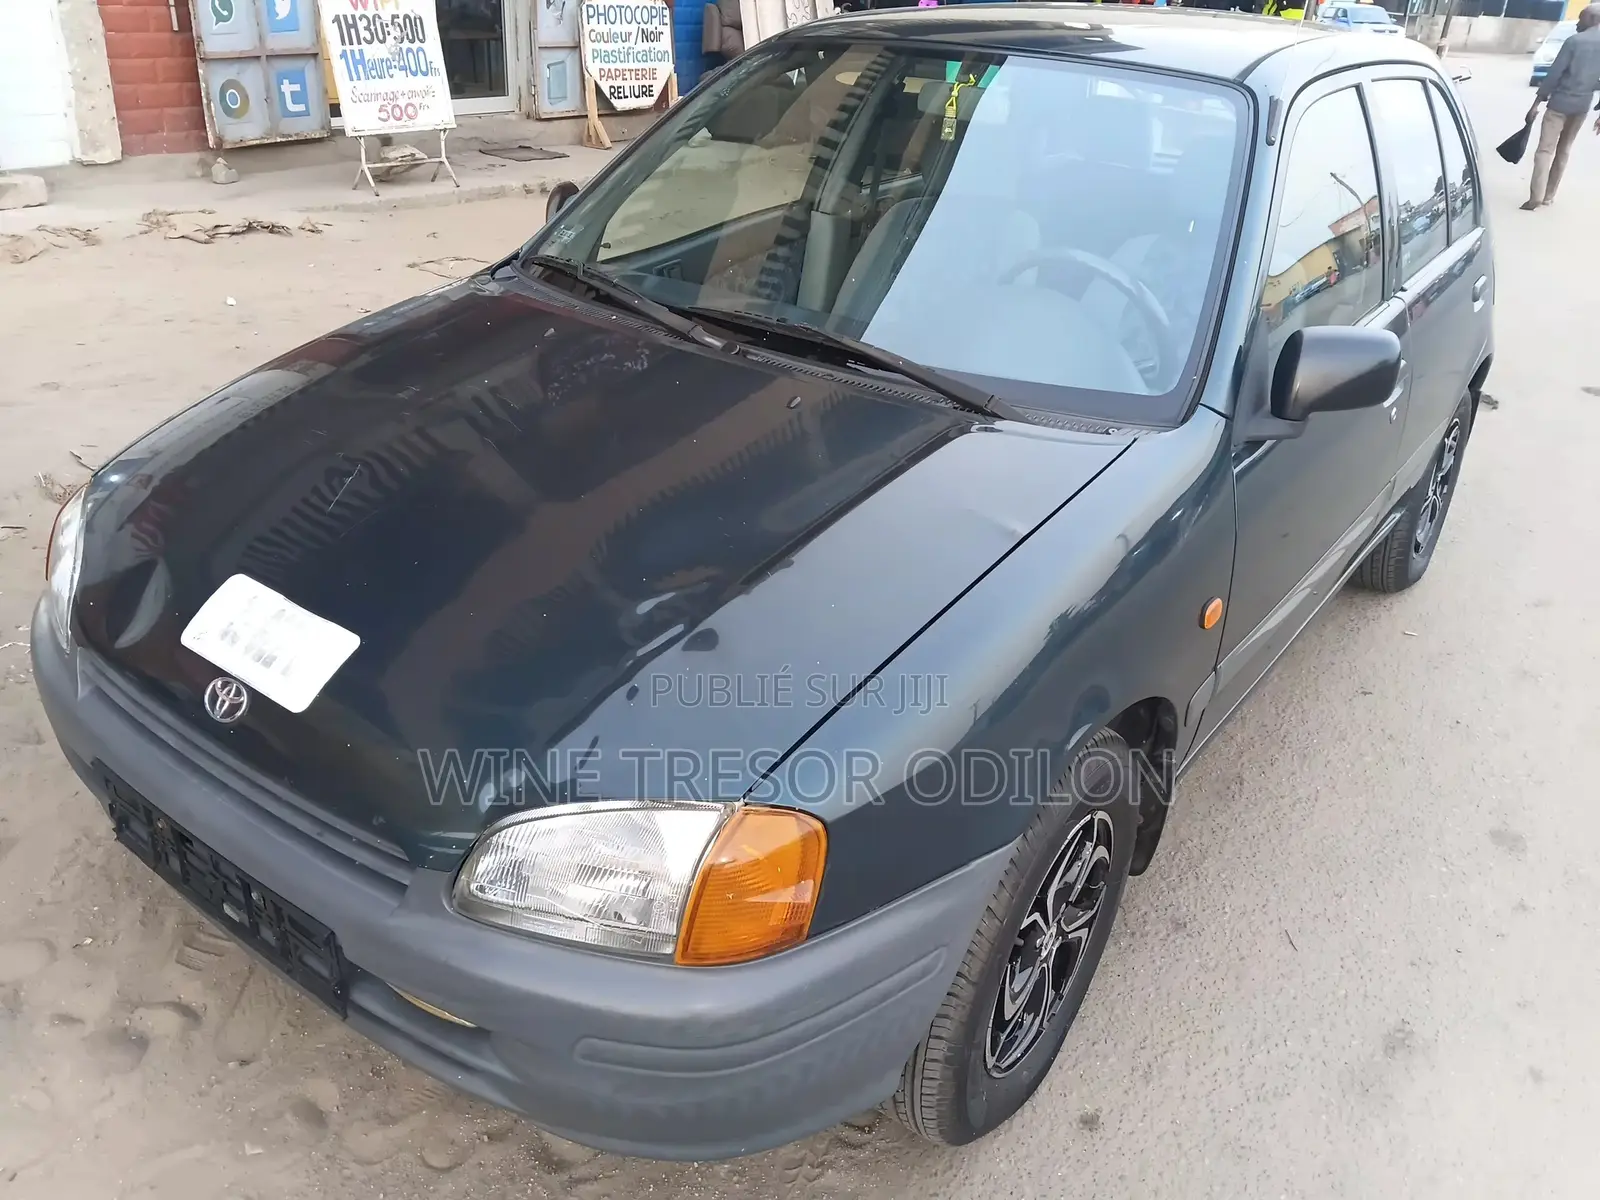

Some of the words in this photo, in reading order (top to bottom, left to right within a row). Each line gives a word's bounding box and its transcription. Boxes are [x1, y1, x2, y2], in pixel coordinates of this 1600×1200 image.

[586, 4, 669, 26] PHOTOCOPIE
[592, 47, 670, 64] Plastification
[598, 67, 658, 82] PAPETERIE
[608, 84, 655, 100] RELIURE
[377, 102, 419, 122] 500
